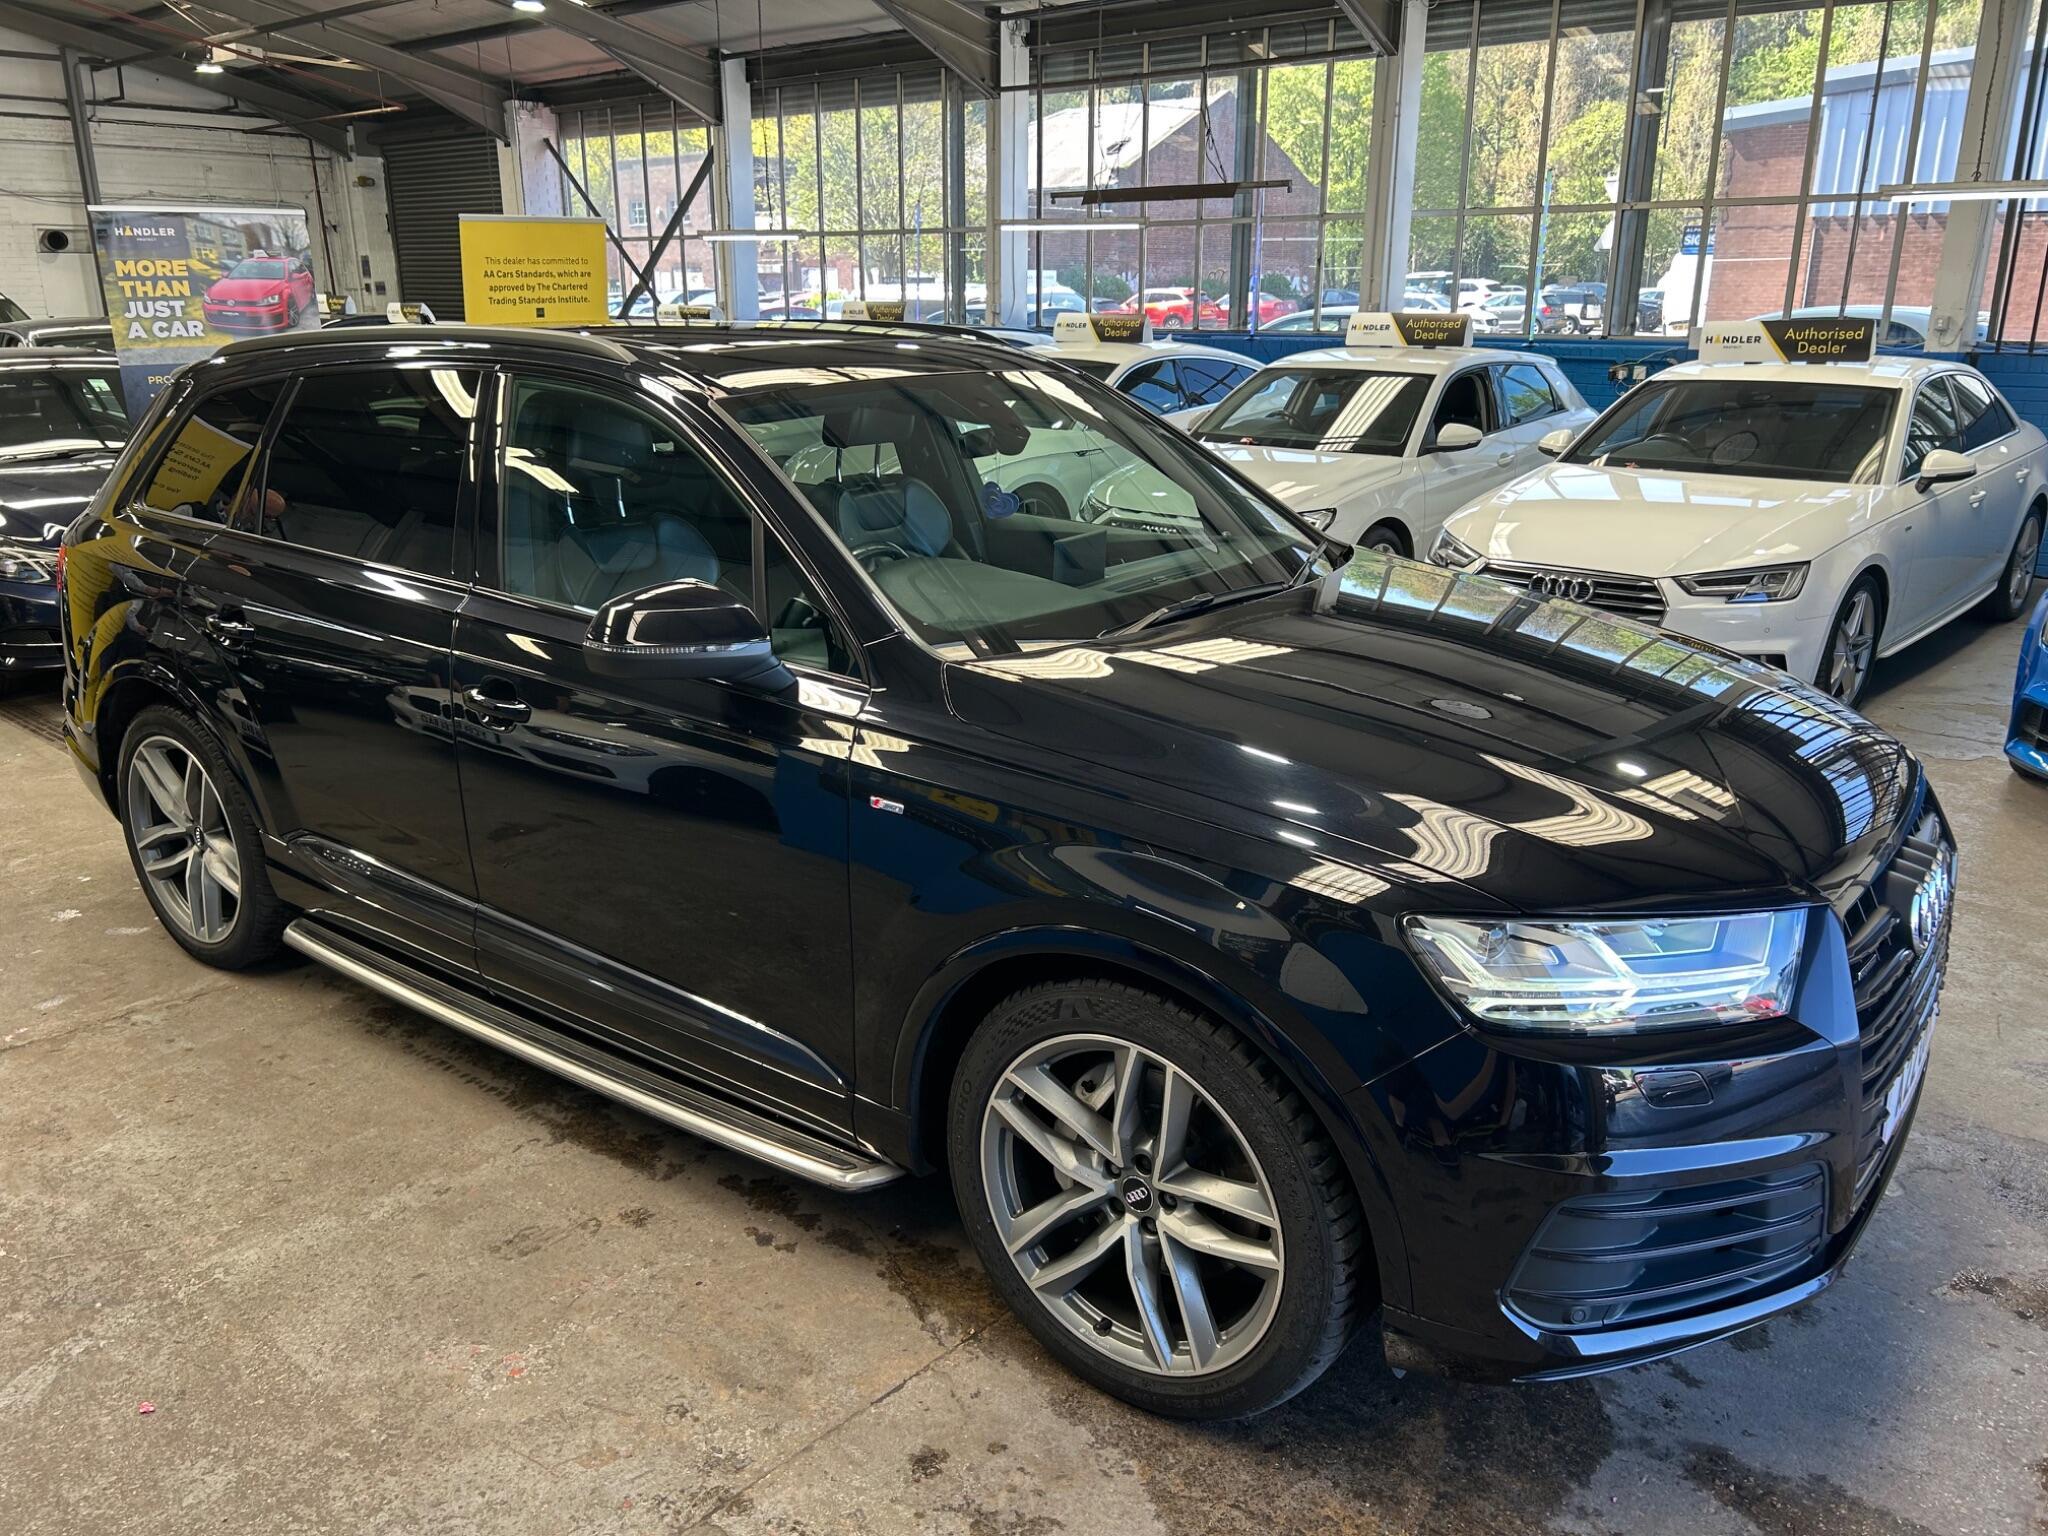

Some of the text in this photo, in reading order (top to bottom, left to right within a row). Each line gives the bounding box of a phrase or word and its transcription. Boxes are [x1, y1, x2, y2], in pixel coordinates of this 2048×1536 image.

[114, 225, 176, 237] HANDLER
[1683, 234, 1716, 246] SIGS
[485, 256, 502, 265] This
[502, 256, 526, 265] dealer
[527, 257, 541, 265] has
[541, 257, 580, 265] committed
[114, 259, 189, 277] MORE
[483, 270, 495, 278] AA
[496, 270, 514, 278] Cars
[515, 269, 556, 279] Standards,
[557, 269, 579, 278] which
[118, 280, 192, 298] THAN
[489, 282, 588, 293] approved by The Chartered
[488, 295, 591, 306] Trading Standards Institute.
[124, 300, 186, 319] JUST
[1099, 319, 1141, 327] Authorised
[1406, 318, 1462, 329] Authorised
[128, 320, 206, 339] A CAR
[1104, 328, 1131, 337] Dealer
[1414, 329, 1449, 340] Dealer
[1784, 326, 1865, 341] Authorised
[1705, 334, 1762, 344] HANDLER
[1797, 341, 1848, 355] Dealer
